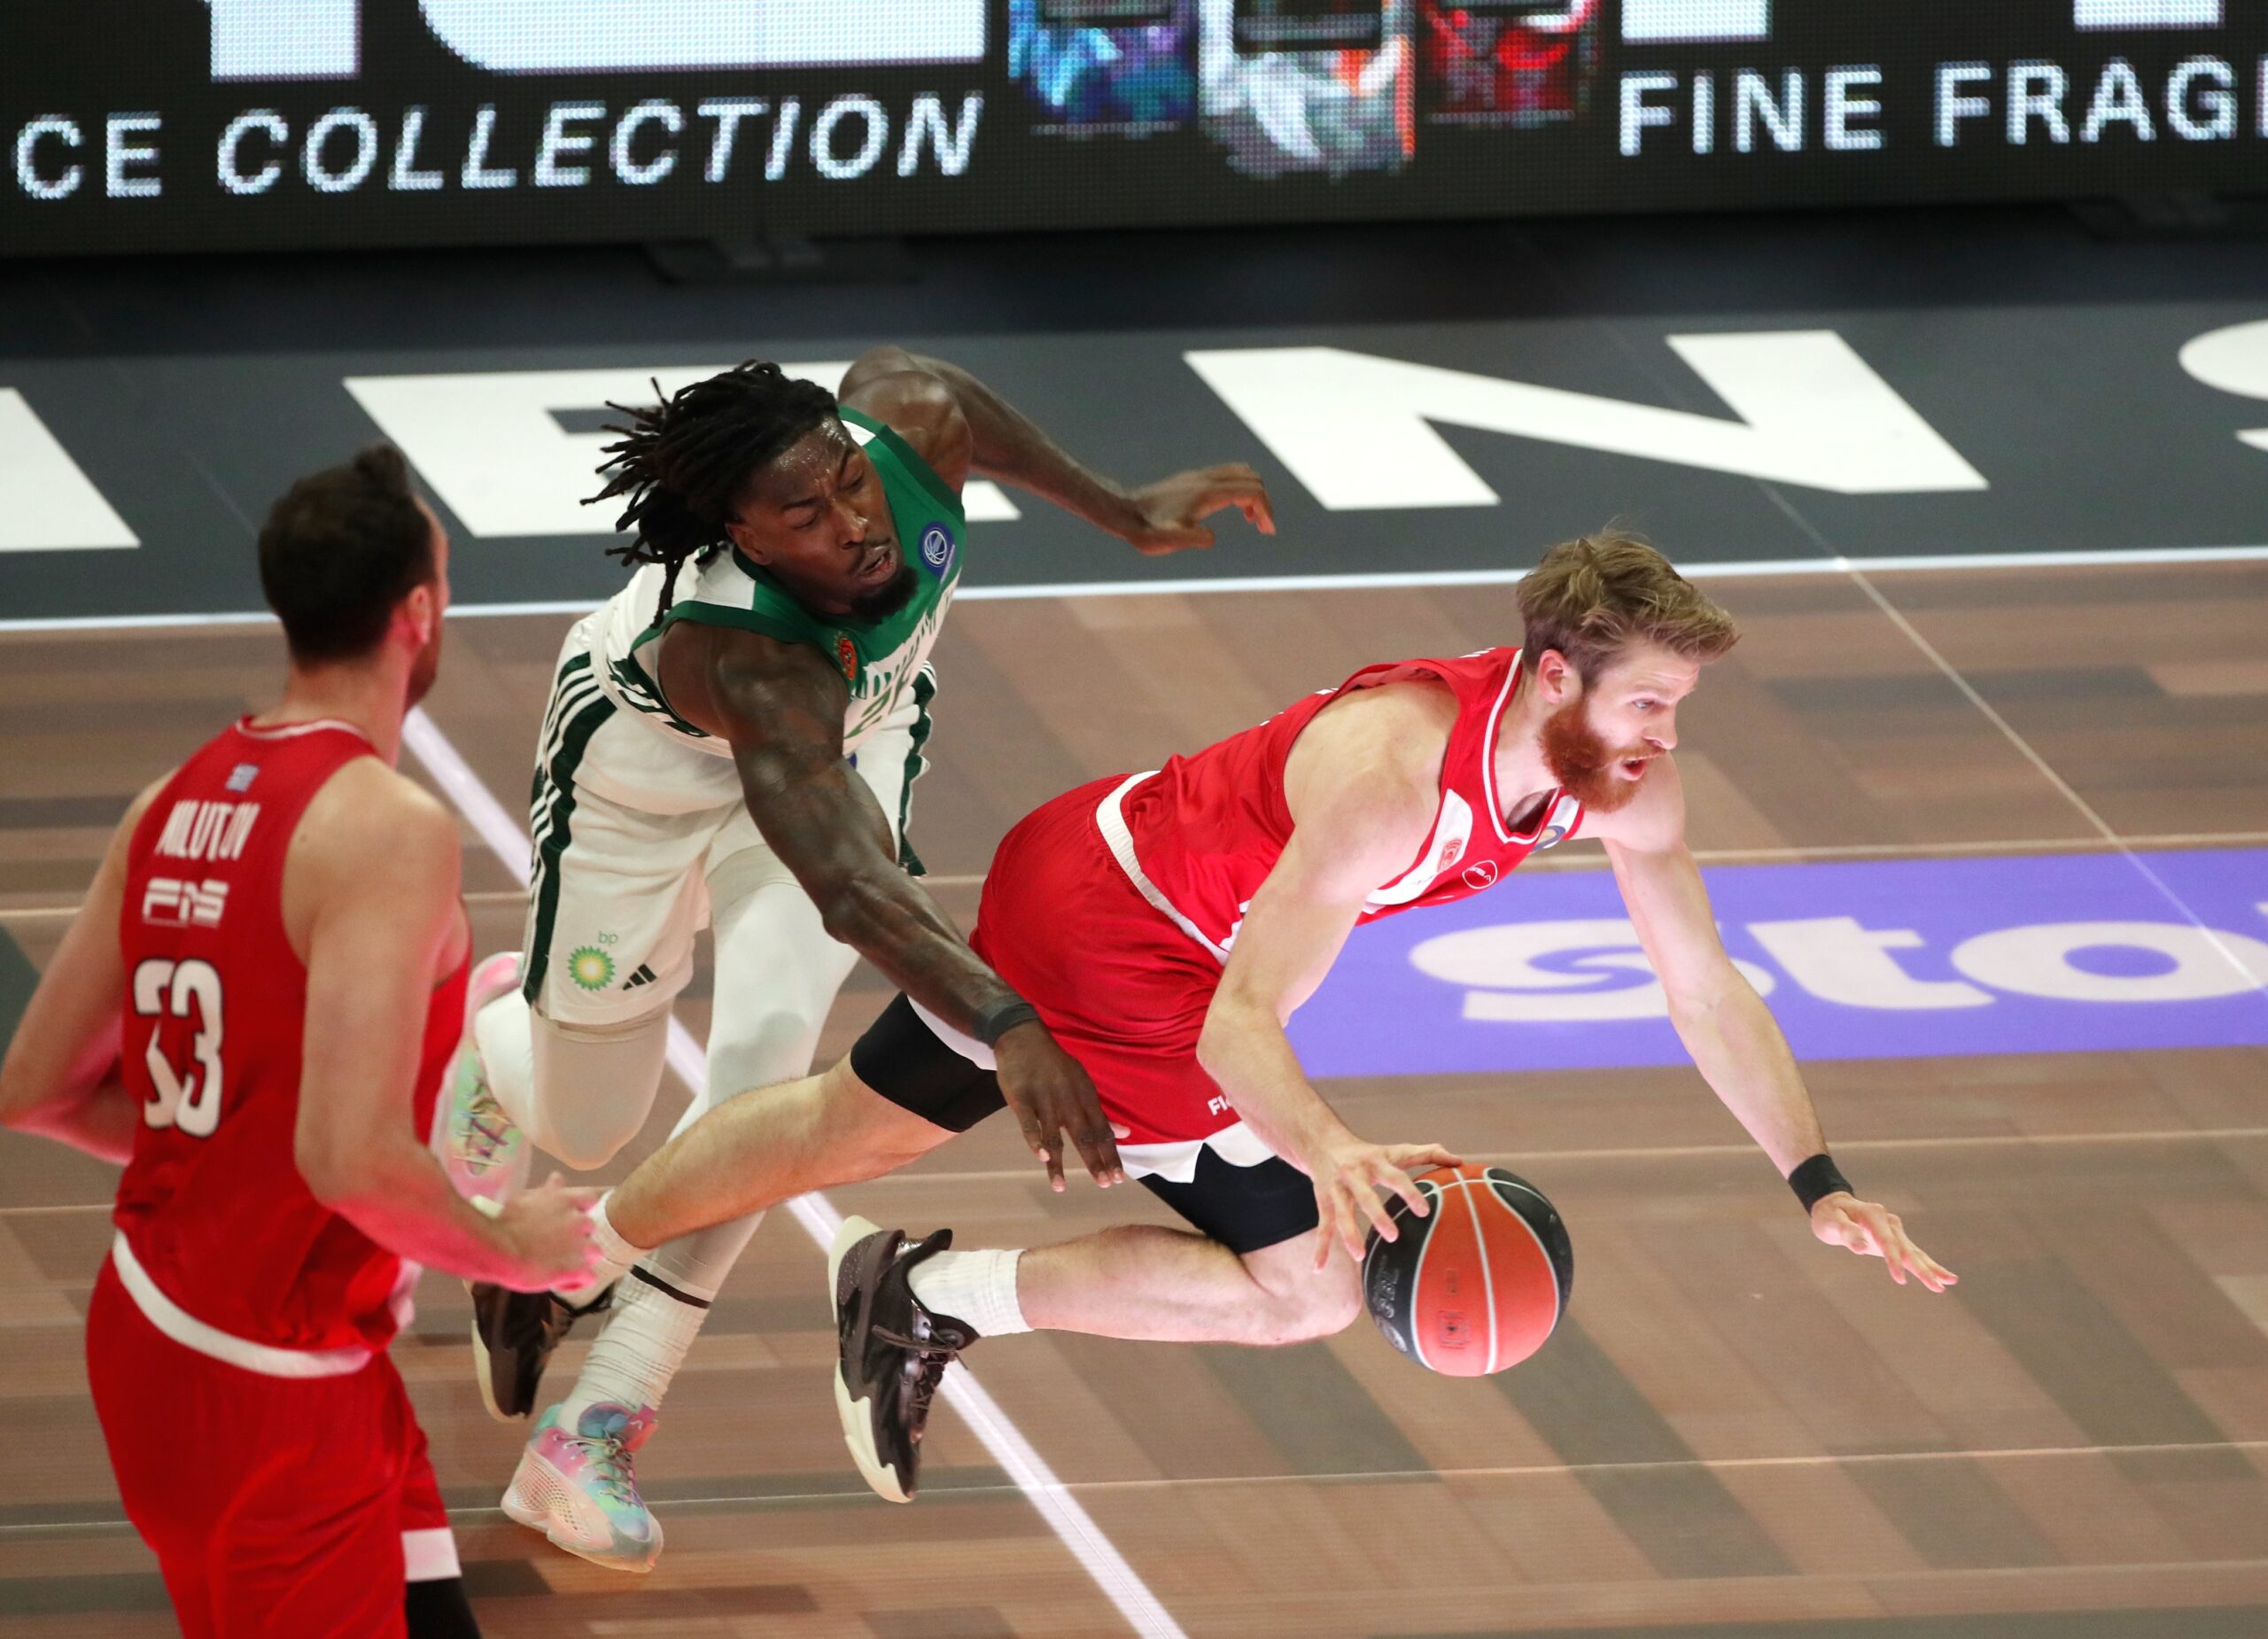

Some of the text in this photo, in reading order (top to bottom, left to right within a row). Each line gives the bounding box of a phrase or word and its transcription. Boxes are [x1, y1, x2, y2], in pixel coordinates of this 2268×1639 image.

[217, 92, 984, 194] COLLECTION
[1619, 54, 2268, 156] FINE FRAG
[598, 931, 619, 946] bp
[1410, 915, 2268, 1021] Sto
